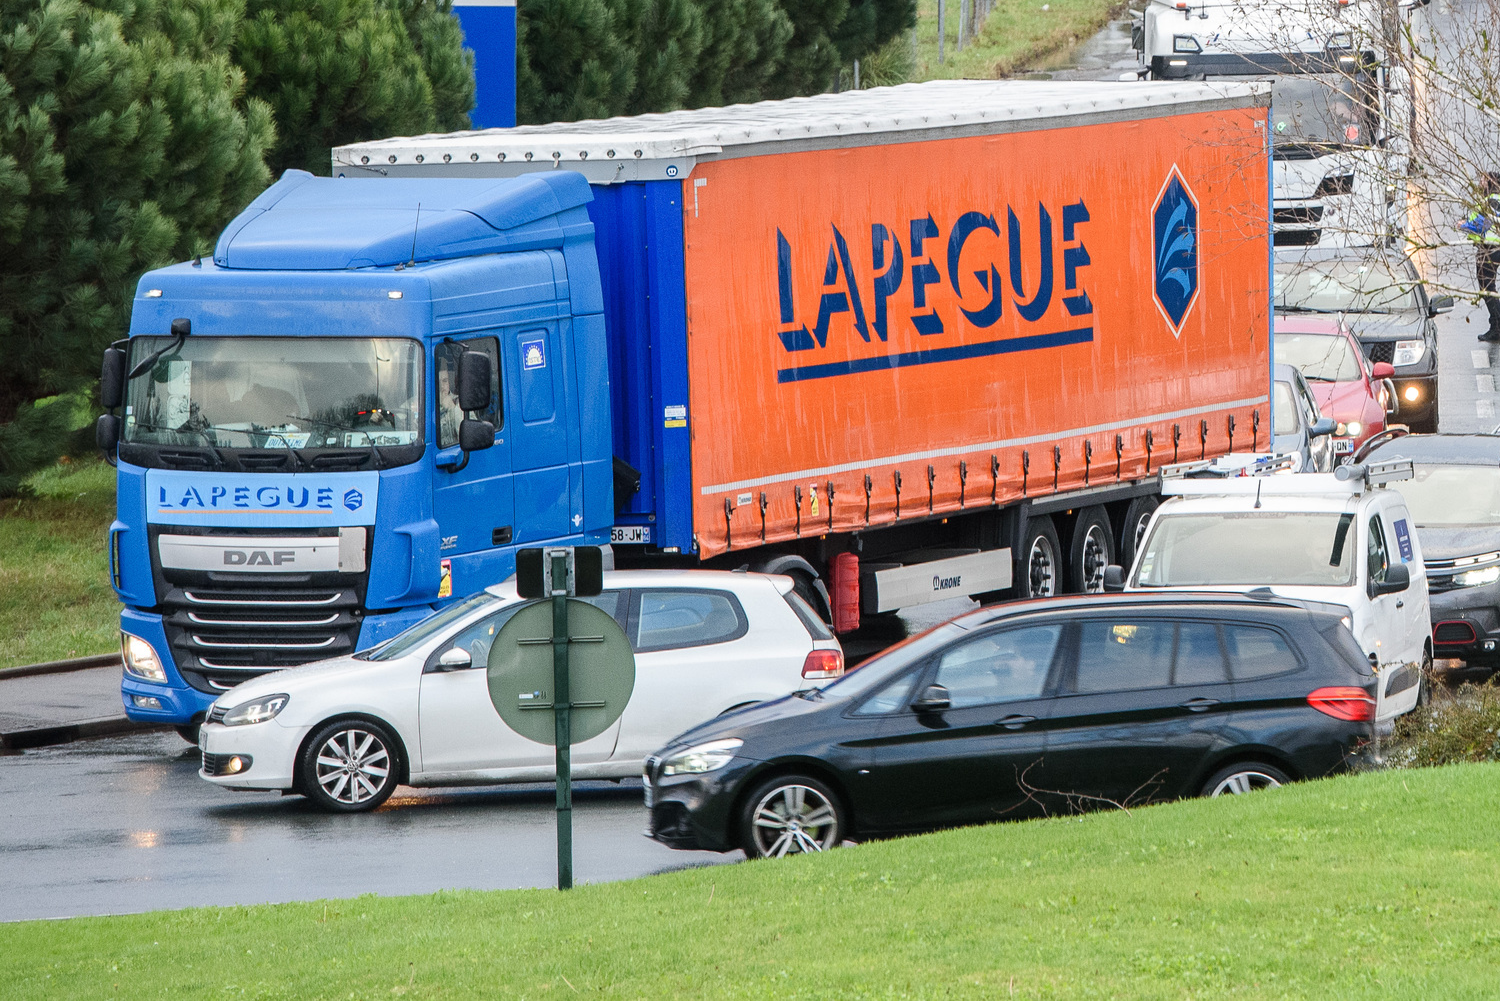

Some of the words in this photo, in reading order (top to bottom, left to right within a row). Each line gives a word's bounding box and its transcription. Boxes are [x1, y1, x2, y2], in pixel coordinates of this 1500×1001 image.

[776, 196, 1095, 352] LAPEGUE
[157, 484, 335, 511] LAPEGUE
[441, 536, 459, 545] XF
[223, 549, 297, 566] DAF
[939, 575, 962, 590] KRONE
